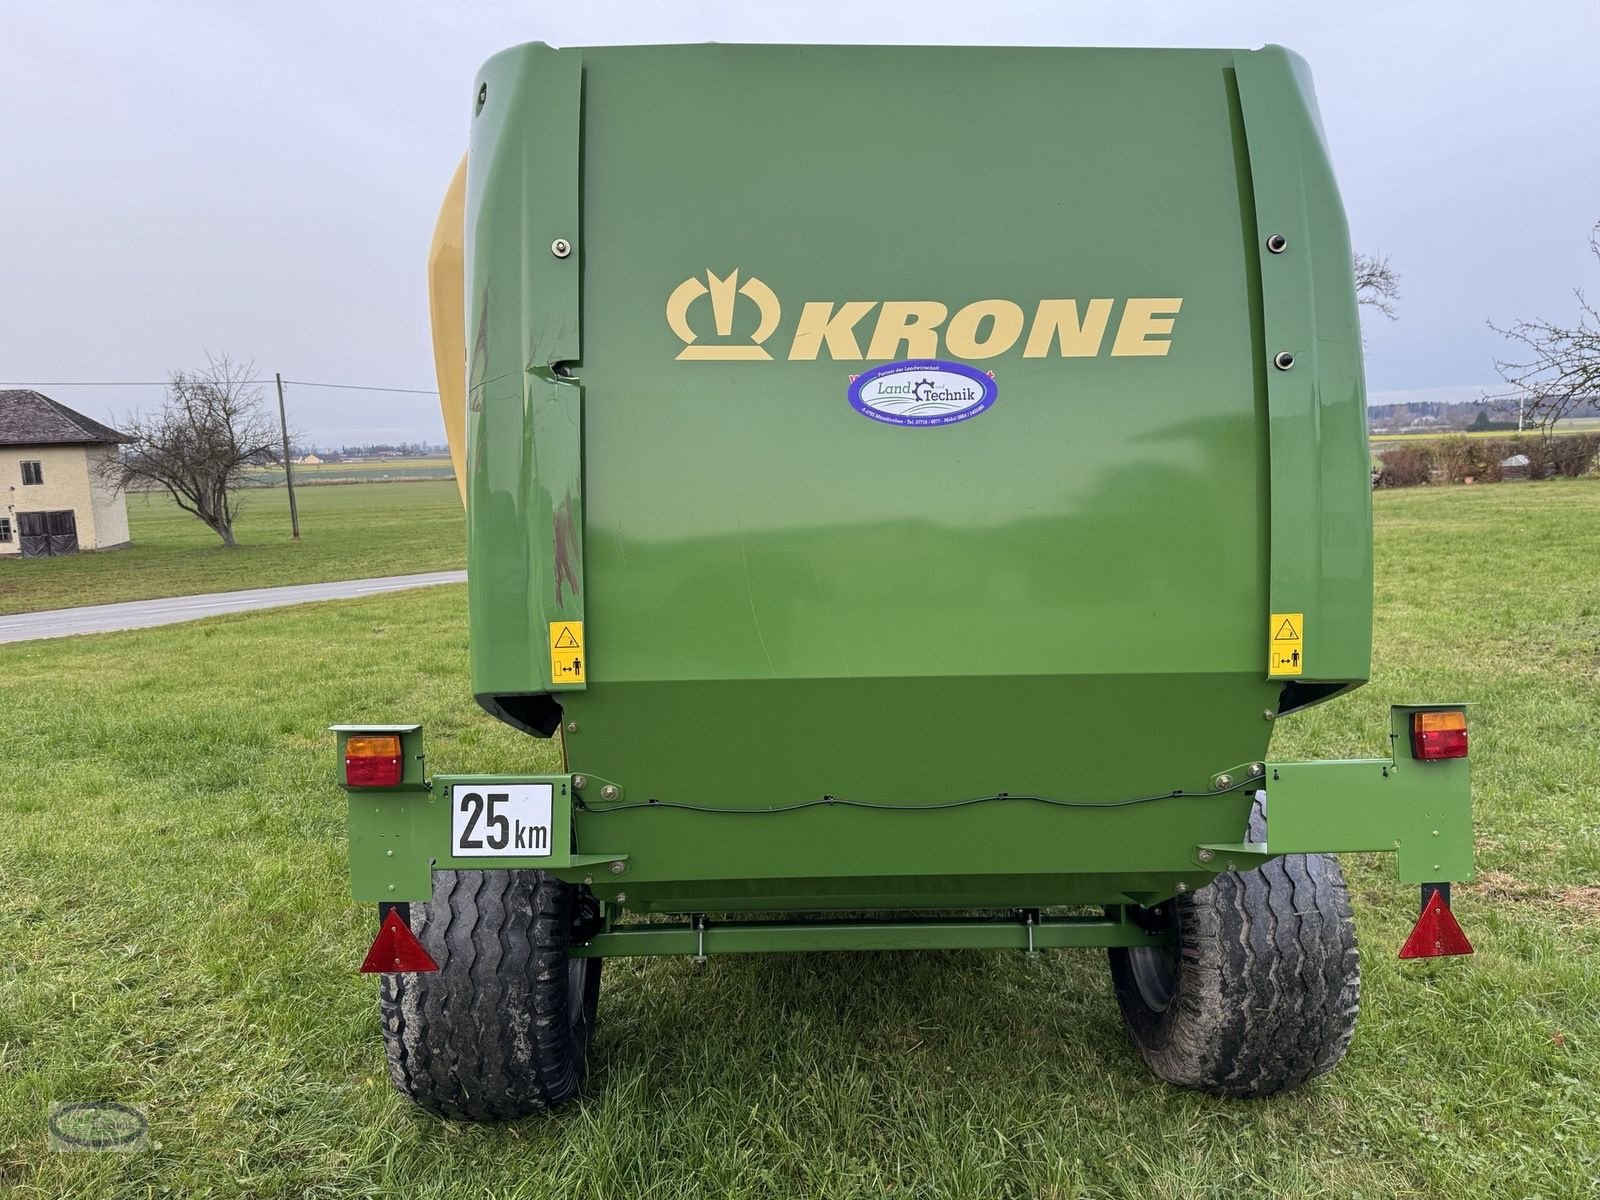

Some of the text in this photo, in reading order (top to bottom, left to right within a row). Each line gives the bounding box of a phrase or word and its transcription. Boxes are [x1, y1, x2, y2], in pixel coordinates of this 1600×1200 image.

[788, 297, 1183, 361] KRONE
[877, 381, 912, 394] Land
[924, 388, 976, 402] Technik
[459, 792, 547, 850] 25 km
